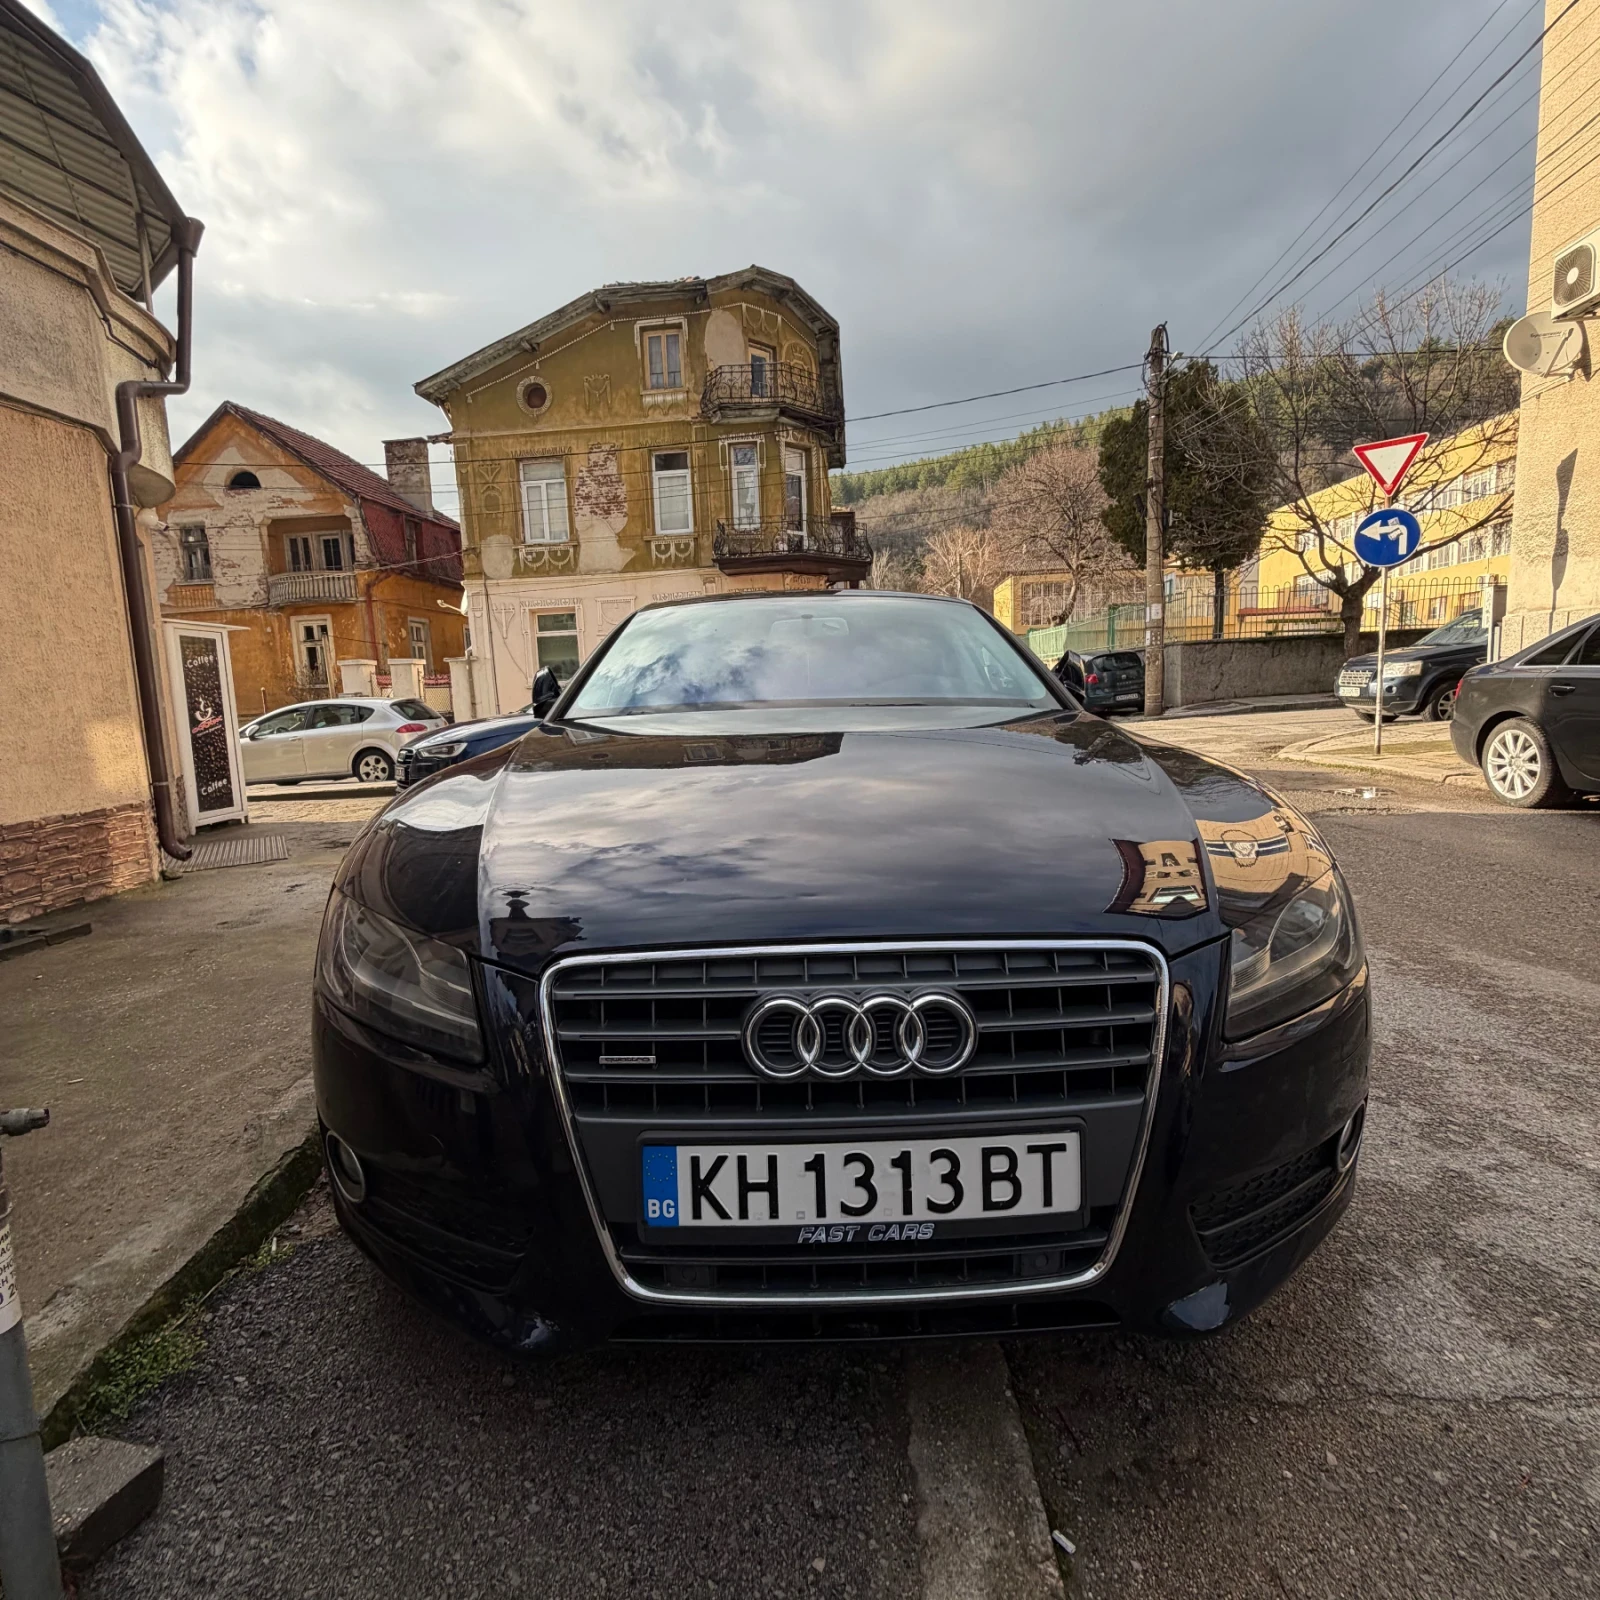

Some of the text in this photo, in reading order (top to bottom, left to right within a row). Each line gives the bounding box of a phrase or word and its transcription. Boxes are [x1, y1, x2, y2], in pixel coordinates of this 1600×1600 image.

[186, 654, 214, 668] Coffee
[201, 778, 228, 796] Coffee
[690, 1142, 1068, 1221] KH 1313 BT
[647, 1199, 676, 1218] BG
[797, 1223, 935, 1244] FAST CARS
